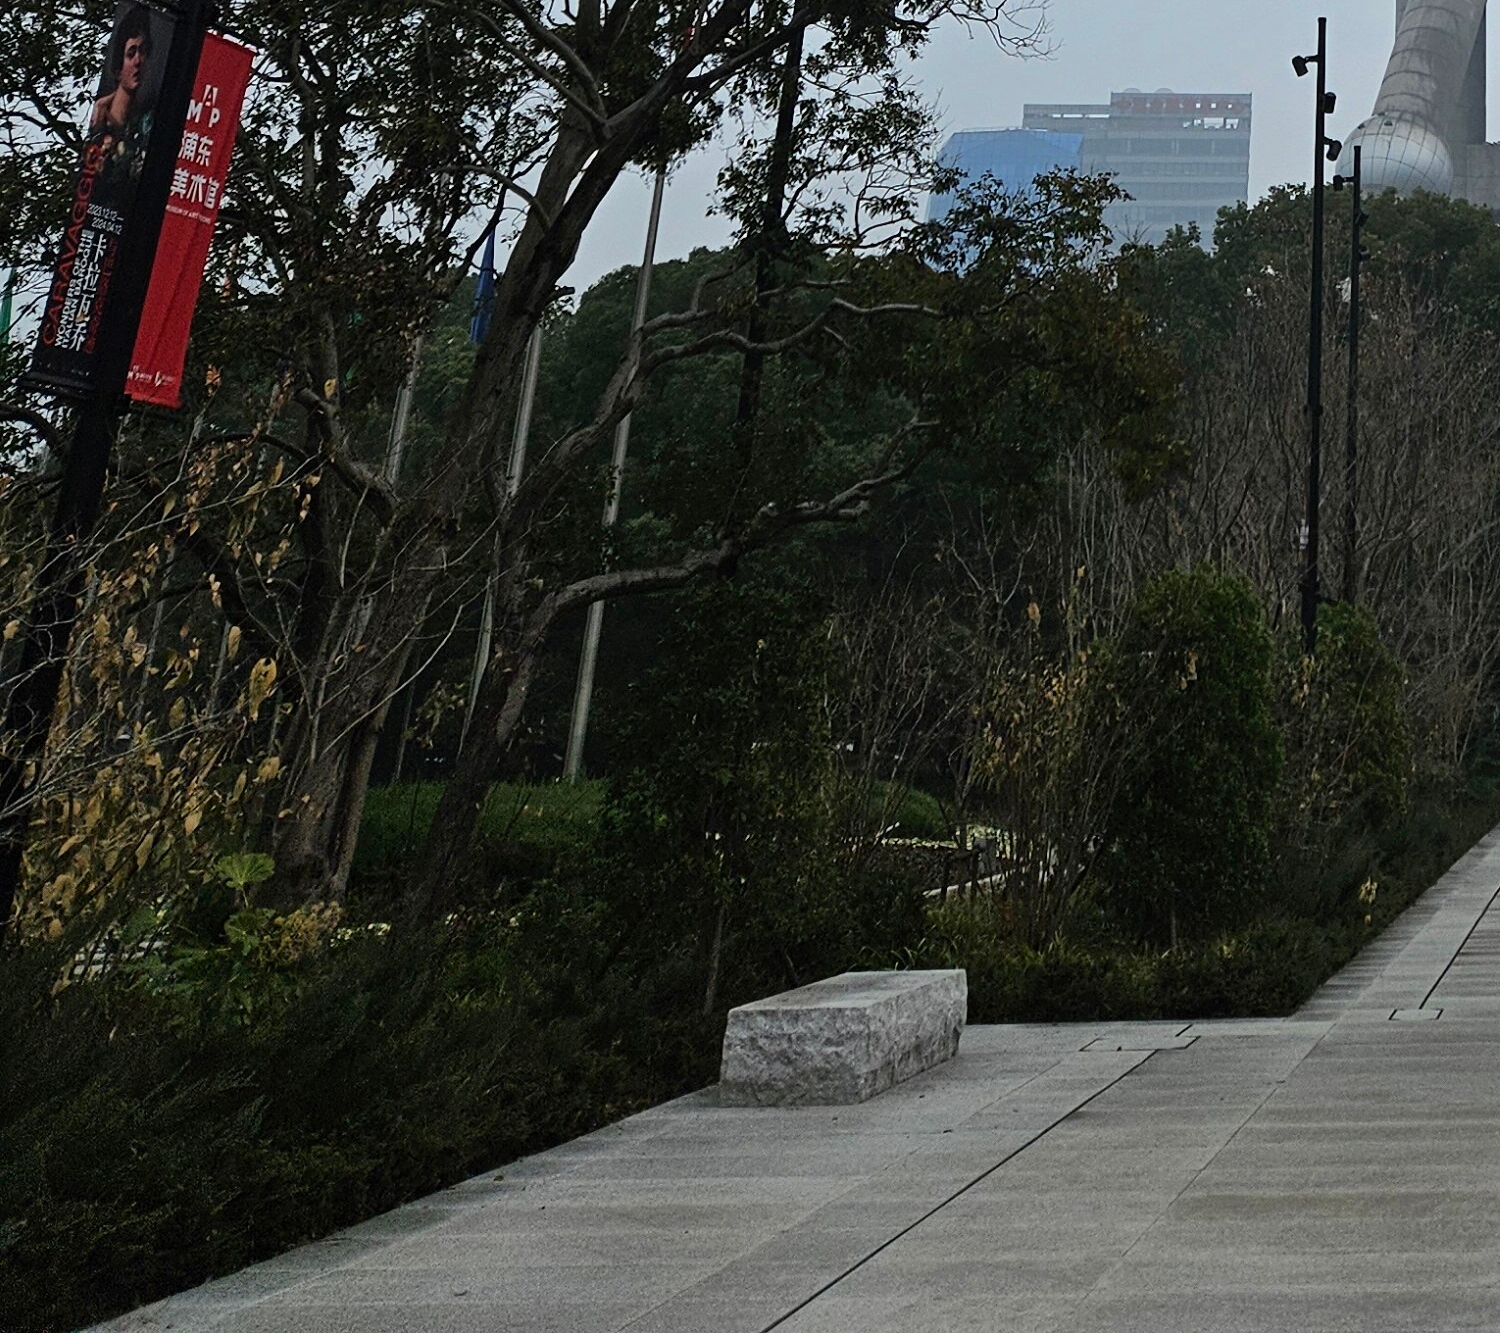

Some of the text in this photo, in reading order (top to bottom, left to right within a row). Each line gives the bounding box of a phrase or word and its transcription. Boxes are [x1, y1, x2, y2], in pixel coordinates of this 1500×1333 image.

[178, 130, 213, 167] 浦东
[43, 144, 102, 346] CARAVAGGIO
[54, 279, 77, 347] WONDERS
[72, 257, 83, 276] OF
[61, 230, 95, 348] ITALIAN BAROQUE
[69, 233, 107, 351] 卡拉瓦乔
